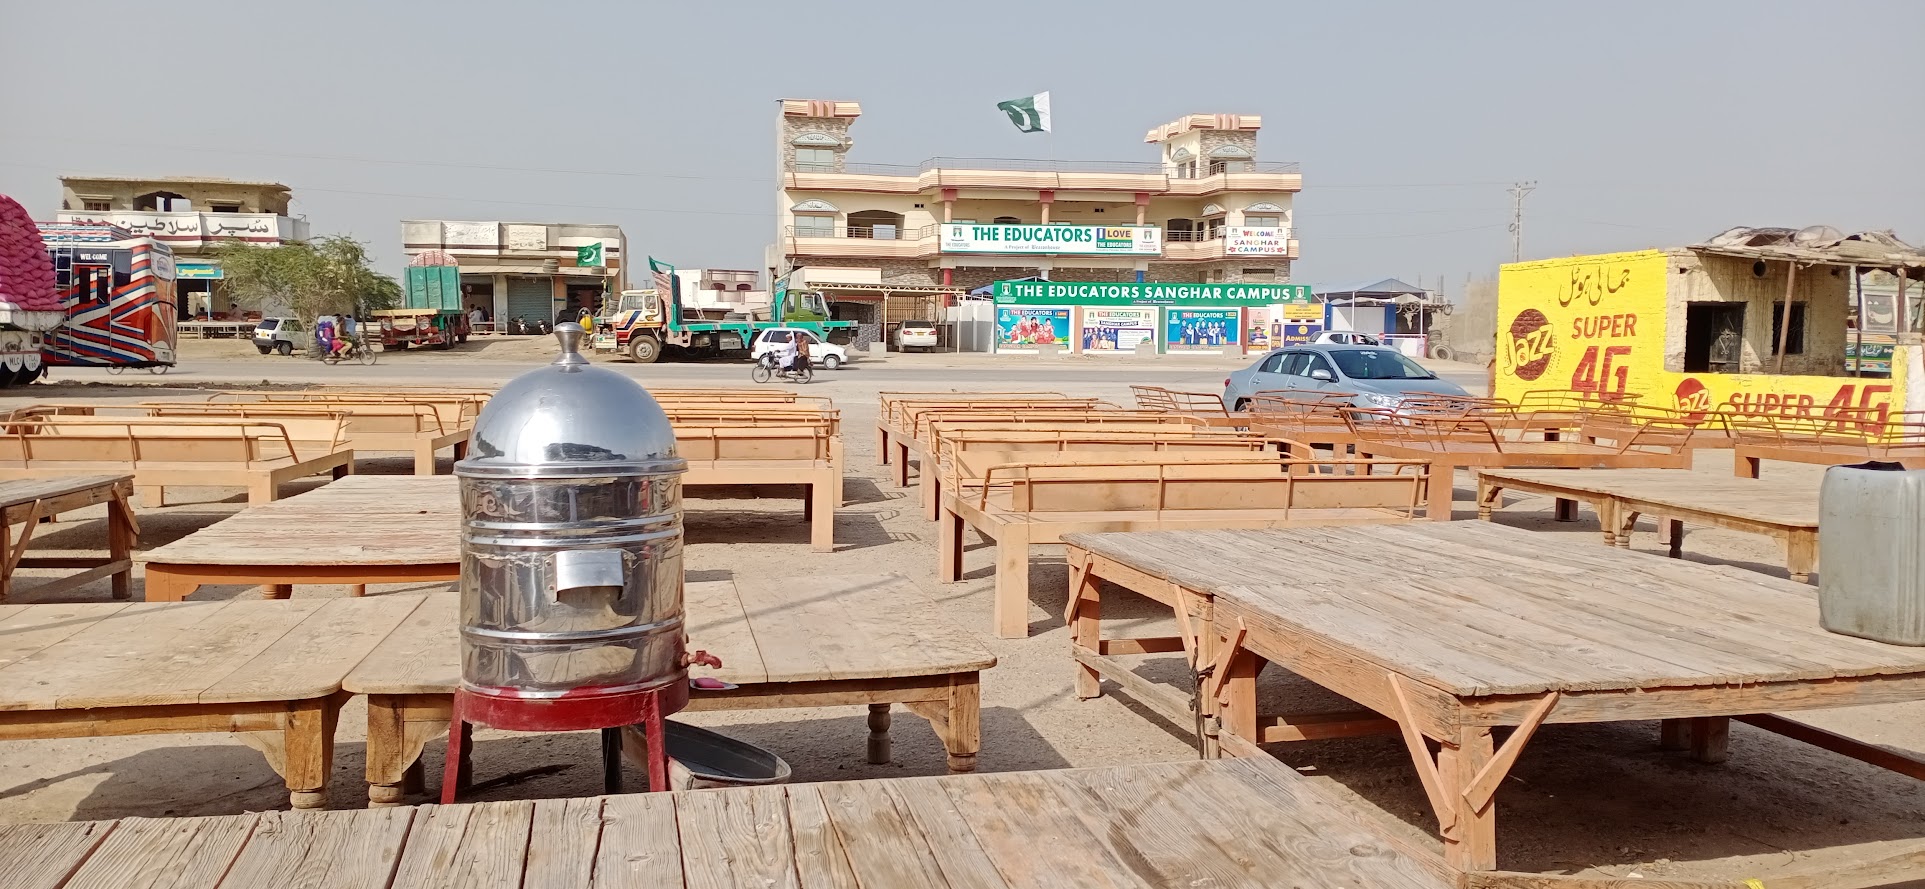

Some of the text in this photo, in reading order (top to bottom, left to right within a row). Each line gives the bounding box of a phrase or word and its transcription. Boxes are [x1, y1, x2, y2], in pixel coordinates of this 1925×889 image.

[972, 227, 1092, 243] THE EDUCATORS
[1107, 230, 1131, 238] LOVE
[1015, 285, 1290, 299] THE EDUCATORS SANGHAR CAMPUS
[1572, 313, 1637, 339] SUPER
[1504, 323, 1555, 376] Jazz
[1571, 346, 1632, 402] 4G
[1673, 388, 1709, 417] Jazz
[1728, 384, 1893, 436] SUPER 4G
